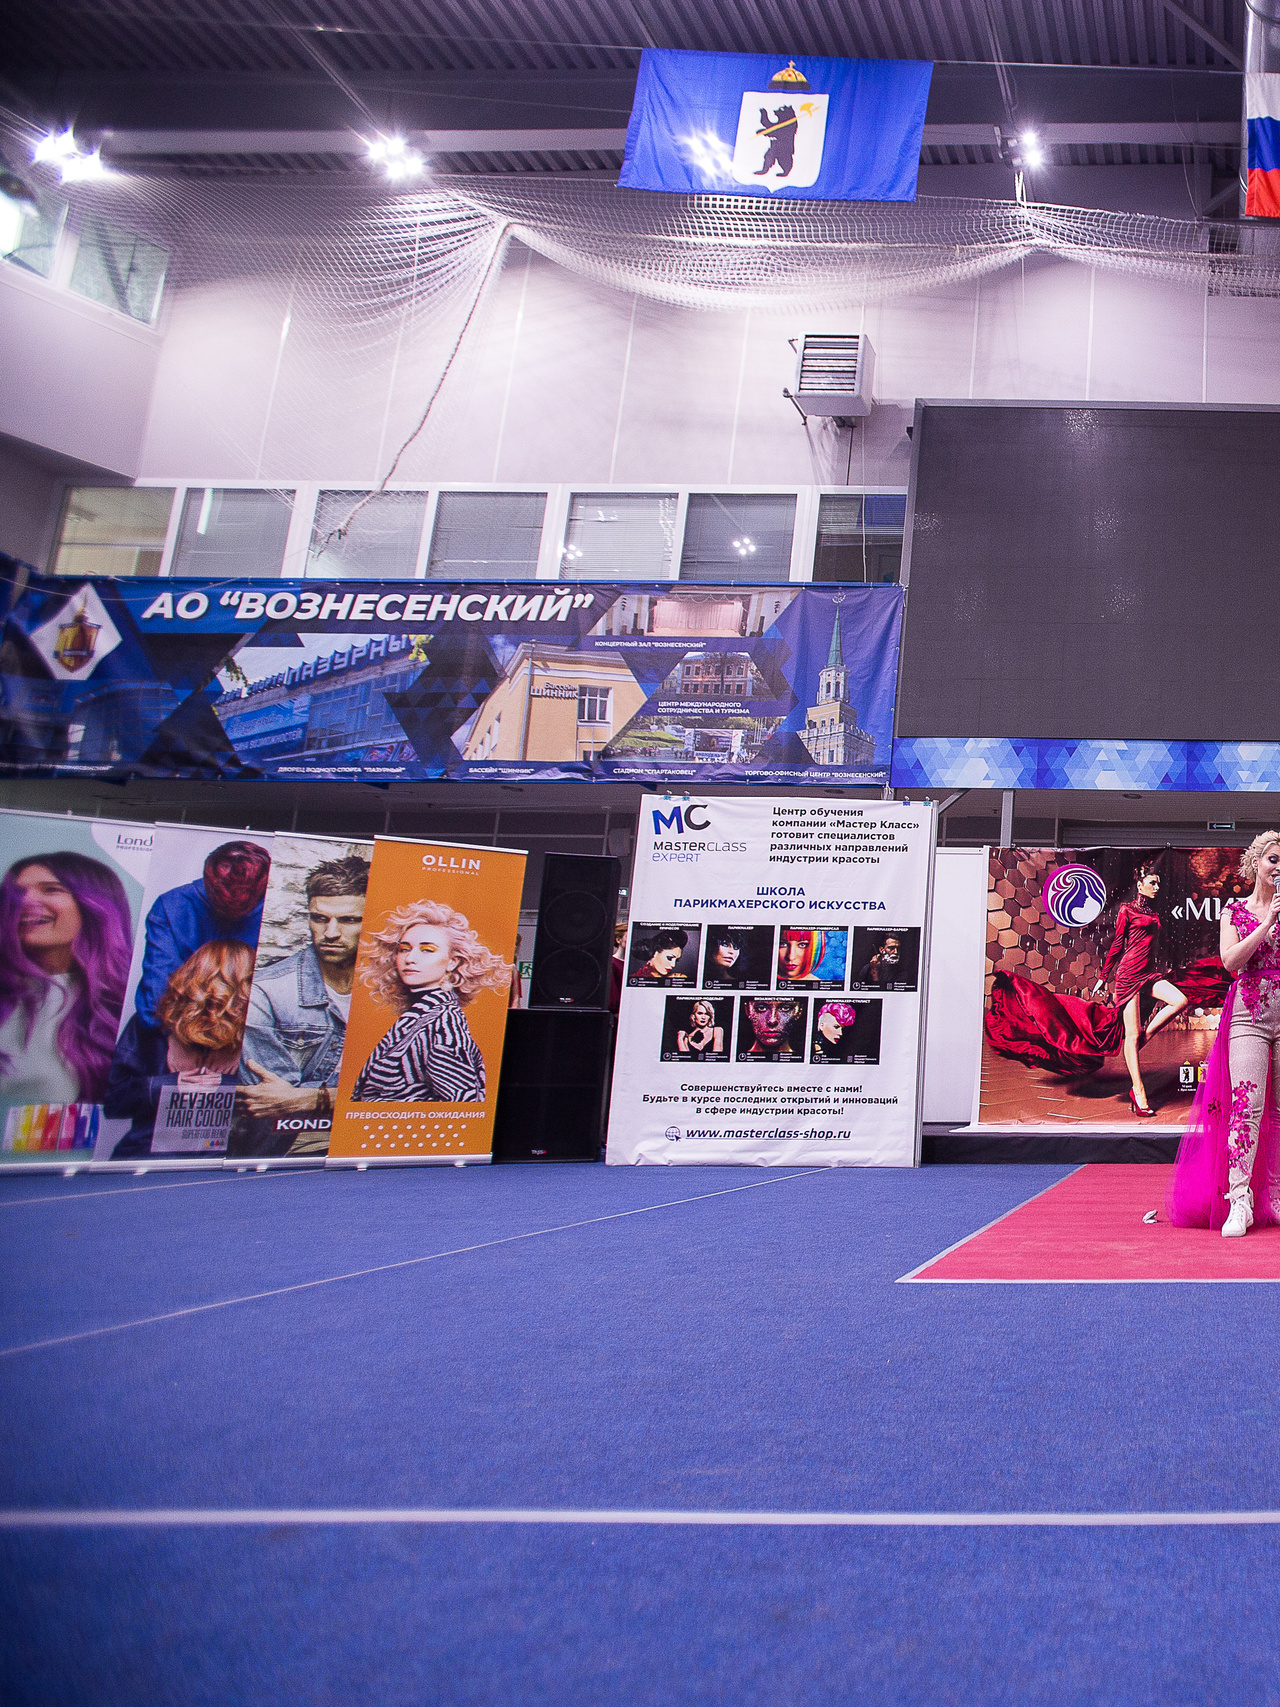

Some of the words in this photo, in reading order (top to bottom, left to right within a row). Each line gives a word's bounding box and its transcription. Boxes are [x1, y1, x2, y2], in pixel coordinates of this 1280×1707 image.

[141, 592, 209, 619] АО
[595, 640, 637, 648] КОНЦЕРТНЫЙ
[468, 766, 498, 774] БАССЕЙН
[745, 770, 809, 778] ТОРГОВО-ОФИСНЫЙ
[773, 807, 807, 817] Центр
[810, 808, 863, 817] обучения
[772, 820, 826, 828] компании
[829, 820, 877, 829] «Мастер
[880, 820, 919, 829] Класс»
[117, 834, 153, 847] Lond
[771, 831, 814, 839] готовит
[817, 832, 895, 840] специалистов
[770, 843, 831, 851] различных
[835, 844, 908, 852] направлений
[422, 854, 481, 870] OLLIN
[769, 855, 829, 864] индустрии
[832, 856, 880, 864] красоты
[422, 866, 479, 876] PROFESSIONAL
[756, 887, 805, 896] ШКОЛА
[673, 898, 805, 910] ПАРИКМАХЕРСКОГО
[809, 900, 886, 911] ИСКУССТВА
[680, 1083, 784, 1094] Совершенствуйтесь
[834, 1084, 863, 1094] нами!
[642, 1094, 680, 1104] Будьте
[691, 1096, 721, 1104] курсе
[723, 1096, 778, 1104] последних
[780, 1095, 830, 1105] открытий
[842, 1095, 898, 1105] инноваций
[345, 1111, 426, 1119] ПРЕВОСХОДИТЬ
[428, 1111, 485, 1119] ОЖИДАНИЯ
[704, 1106, 737, 1115] сфере
[740, 1107, 794, 1116] индустрии
[797, 1107, 844, 1116] красоты!
[166, 1110, 193, 1127] HAIR
[195, 1110, 231, 1127] COLOR
[276, 1119, 332, 1130] KOND
[686, 1127, 851, 1141] www.masterclass-shop.ru
